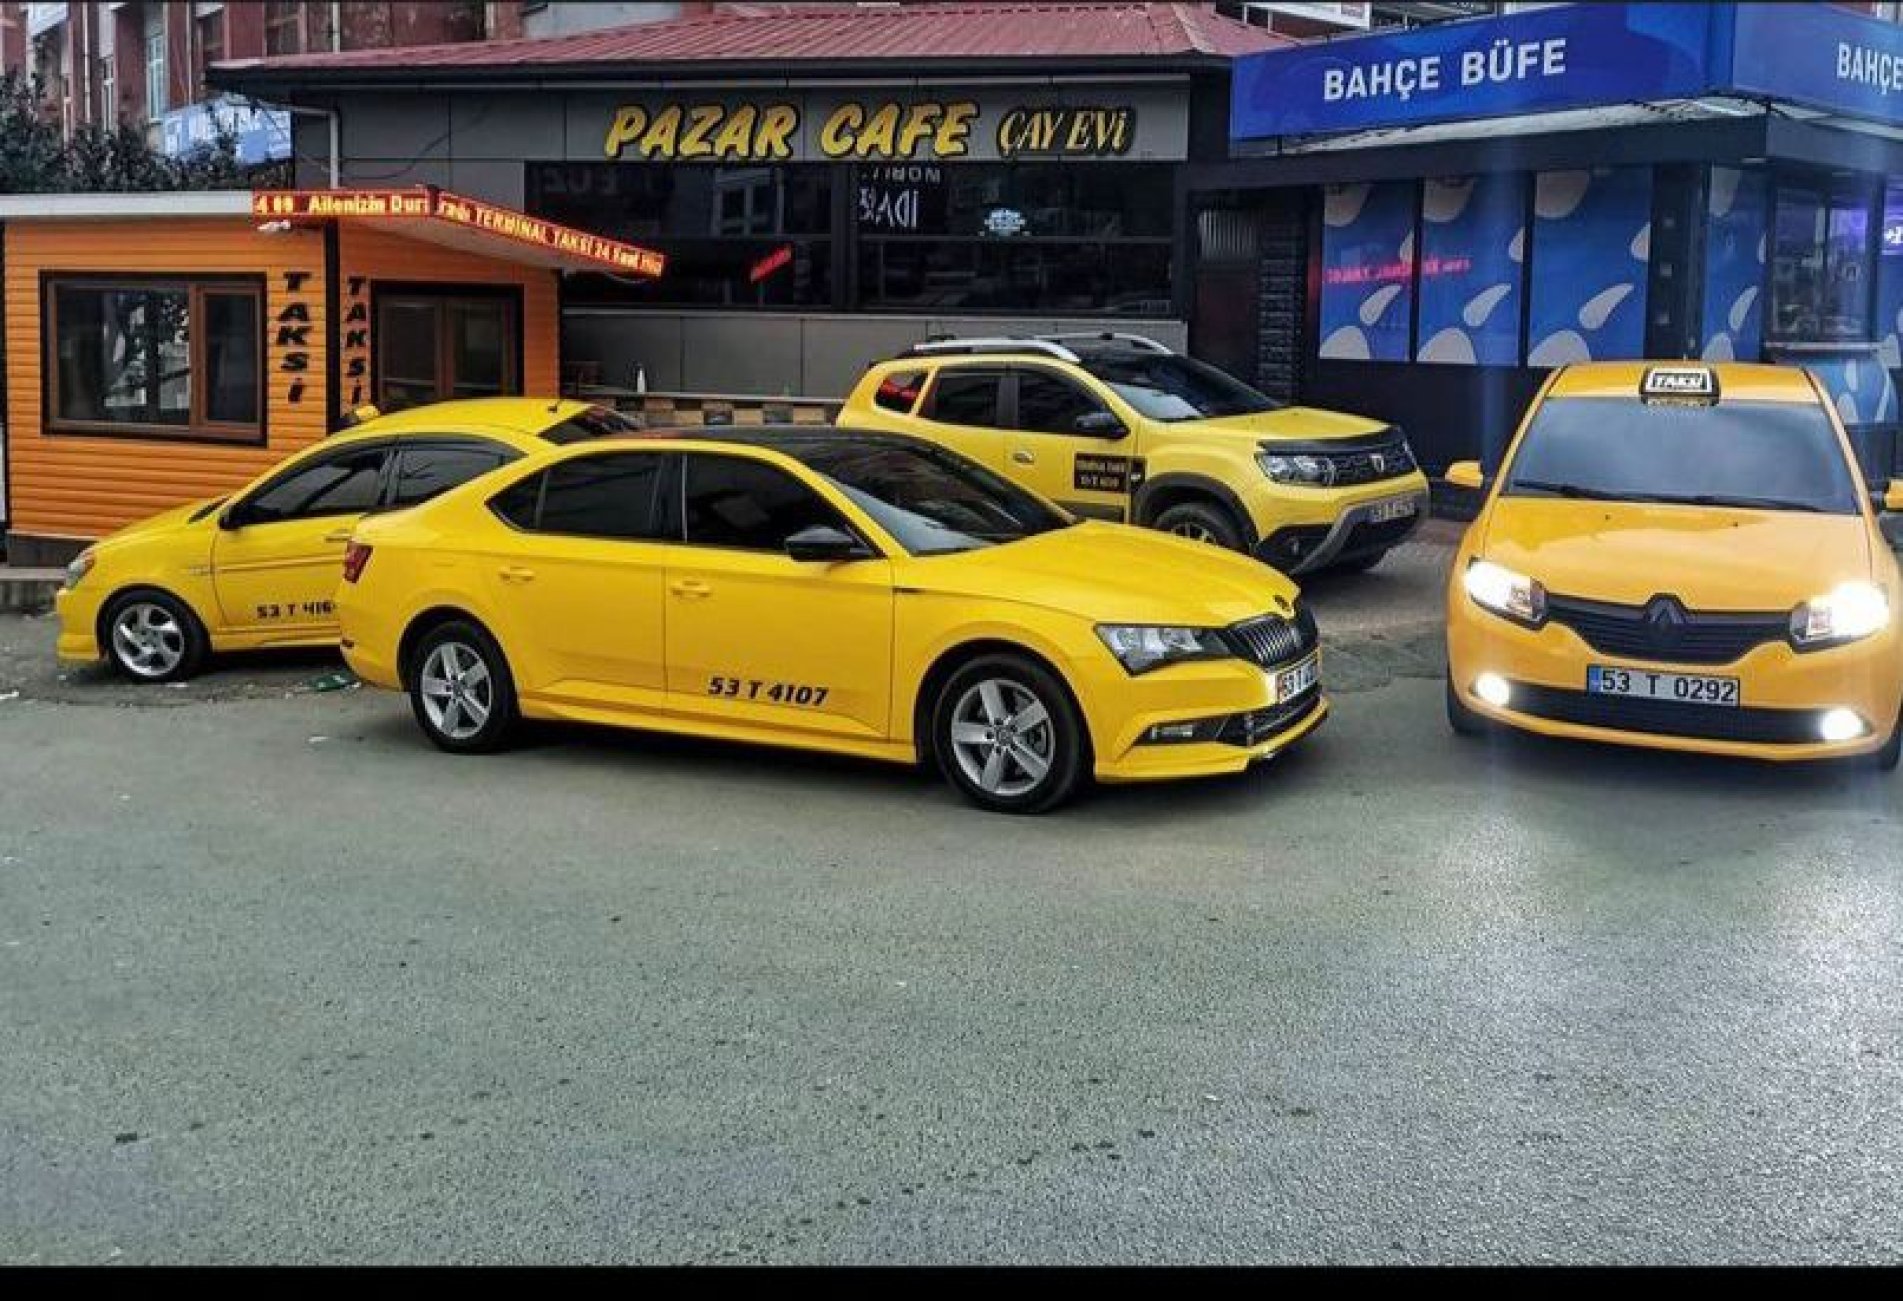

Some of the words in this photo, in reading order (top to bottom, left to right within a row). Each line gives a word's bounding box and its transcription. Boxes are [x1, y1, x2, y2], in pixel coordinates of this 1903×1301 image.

[1324, 56, 1441, 100] BAHÇE
[1461, 38, 1567, 86] BÜFE
[1836, 42, 1903, 95] BAHÇE
[605, 103, 798, 158] PAZAR
[821, 103, 978, 156] CAFE
[1000, 110, 1065, 157] ÇAY
[276, 271, 313, 403] TAKSİ
[345, 275, 367, 404] TAKSİ
[256, 603, 280, 618] 53
[286, 603, 296, 617] T
[302, 600, 336, 615] 416
[707, 676, 740, 695] 53
[748, 679, 763, 699] T
[766, 683, 829, 706] 4107
[1601, 670, 1630, 693] 53
[1645, 674, 1661, 695] T
[1673, 676, 1737, 702] 0292
